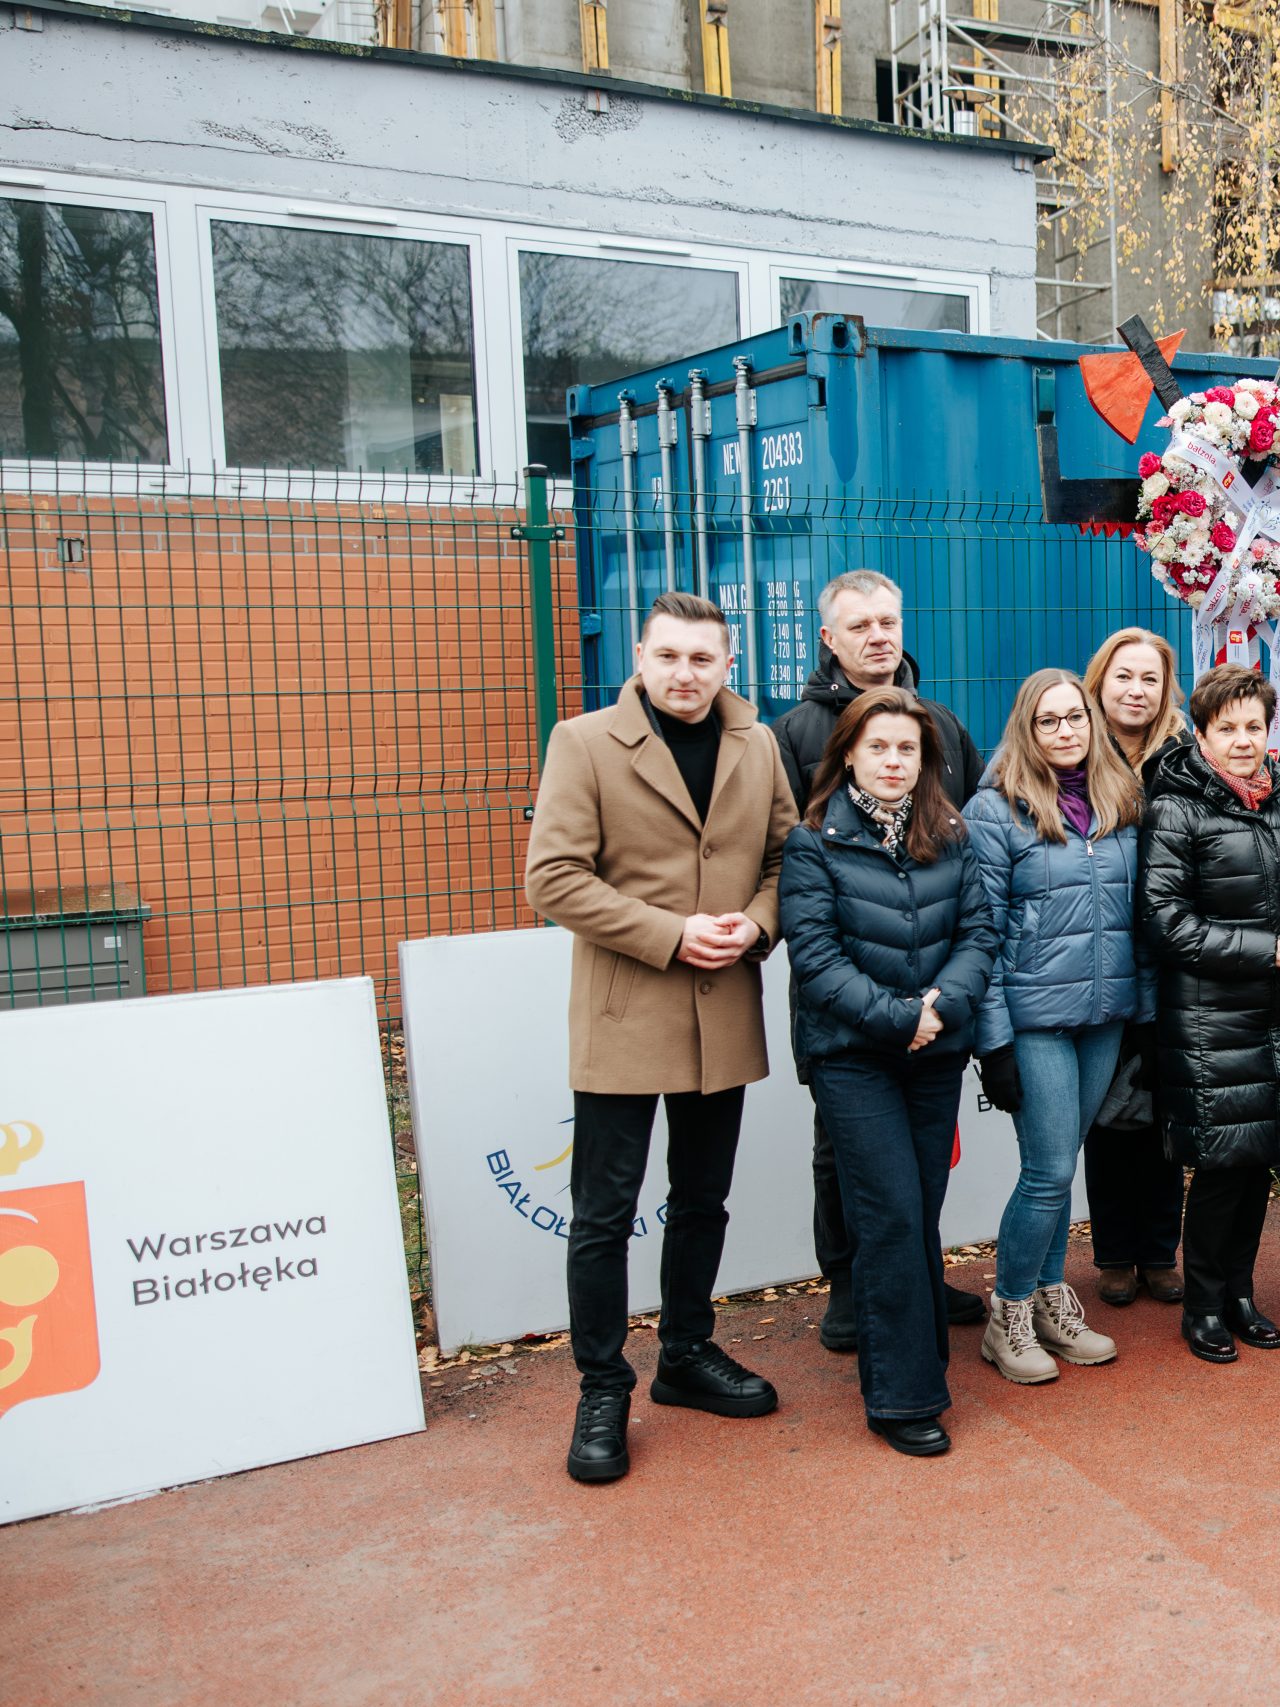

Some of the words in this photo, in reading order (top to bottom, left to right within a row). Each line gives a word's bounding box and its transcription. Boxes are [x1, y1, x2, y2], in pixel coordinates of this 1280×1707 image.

[723, 441, 742, 475] NEW
[762, 431, 803, 470] 204383
[1187, 442, 1217, 466] balzola
[764, 476, 790, 512] 22G1
[1206, 584, 1227, 613] balzola
[795, 642, 807, 659] LBS
[126, 1216, 326, 1263] Warszawa
[133, 1256, 318, 1306] Białołęka
